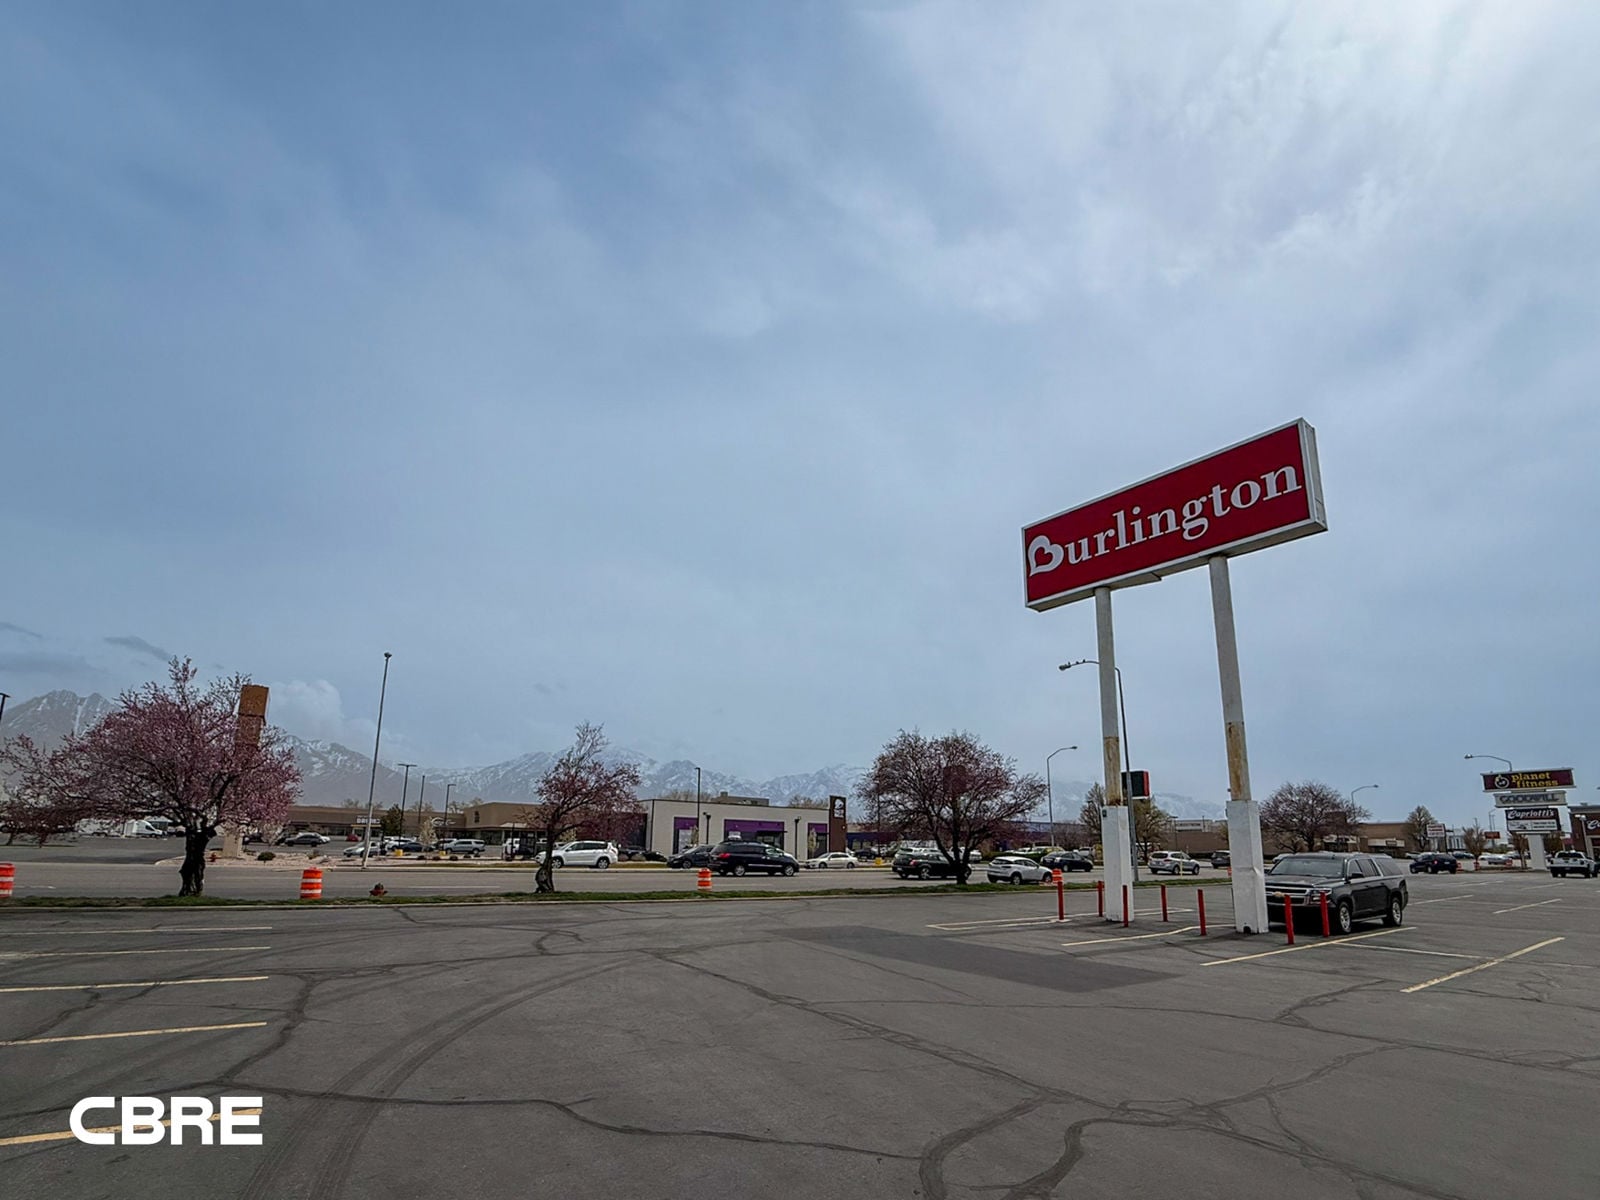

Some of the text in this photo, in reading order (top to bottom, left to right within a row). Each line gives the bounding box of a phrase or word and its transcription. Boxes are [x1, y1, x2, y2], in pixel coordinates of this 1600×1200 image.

[1028, 465, 1302, 577] Burlington
[1511, 772, 1551, 782] planet
[1516, 780, 1559, 788] fitness
